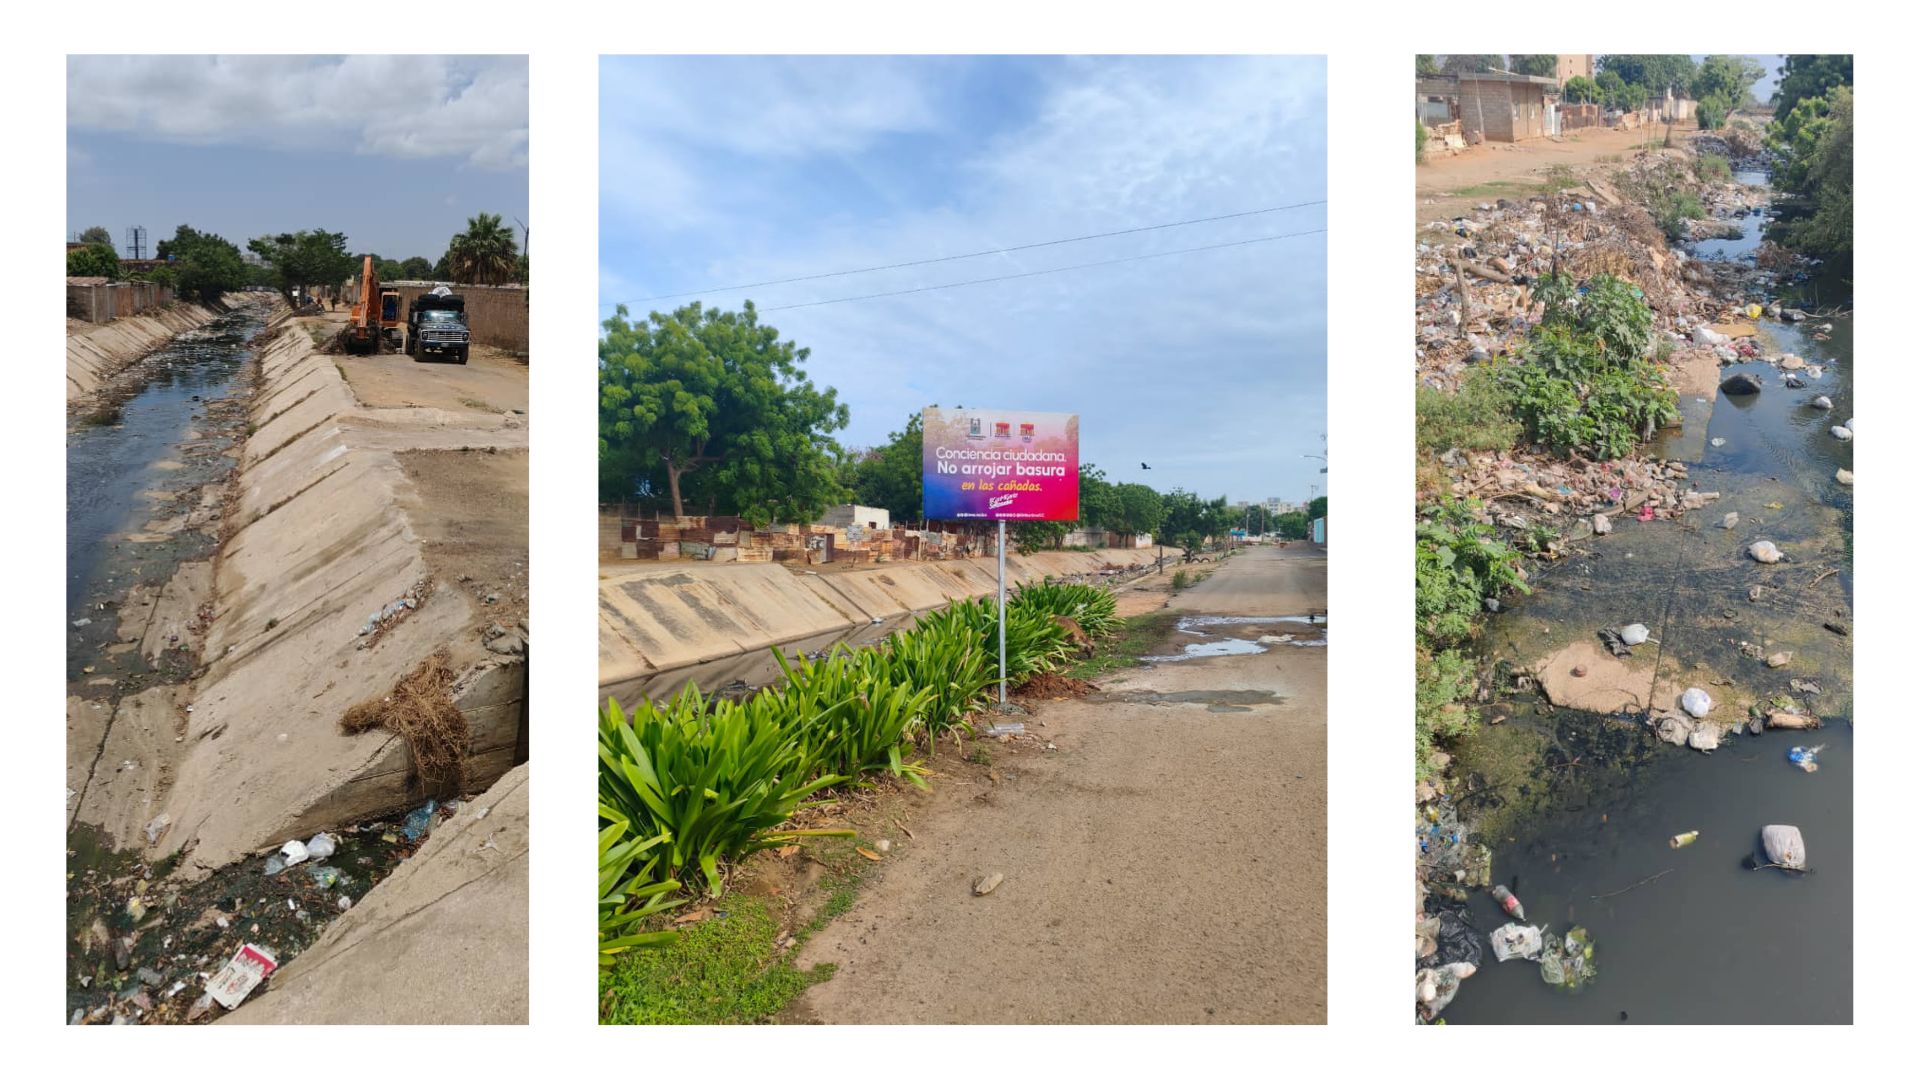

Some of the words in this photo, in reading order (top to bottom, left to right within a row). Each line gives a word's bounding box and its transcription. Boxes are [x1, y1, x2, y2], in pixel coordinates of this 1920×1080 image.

[936, 447, 1001, 461] Conciencia
[937, 461, 957, 474] No
[962, 463, 1012, 479] arrojar
[1016, 464, 1066, 477] basura
[961, 481, 975, 491] en
[978, 479, 994, 491] las
[998, 479, 1043, 492] cañadas.
